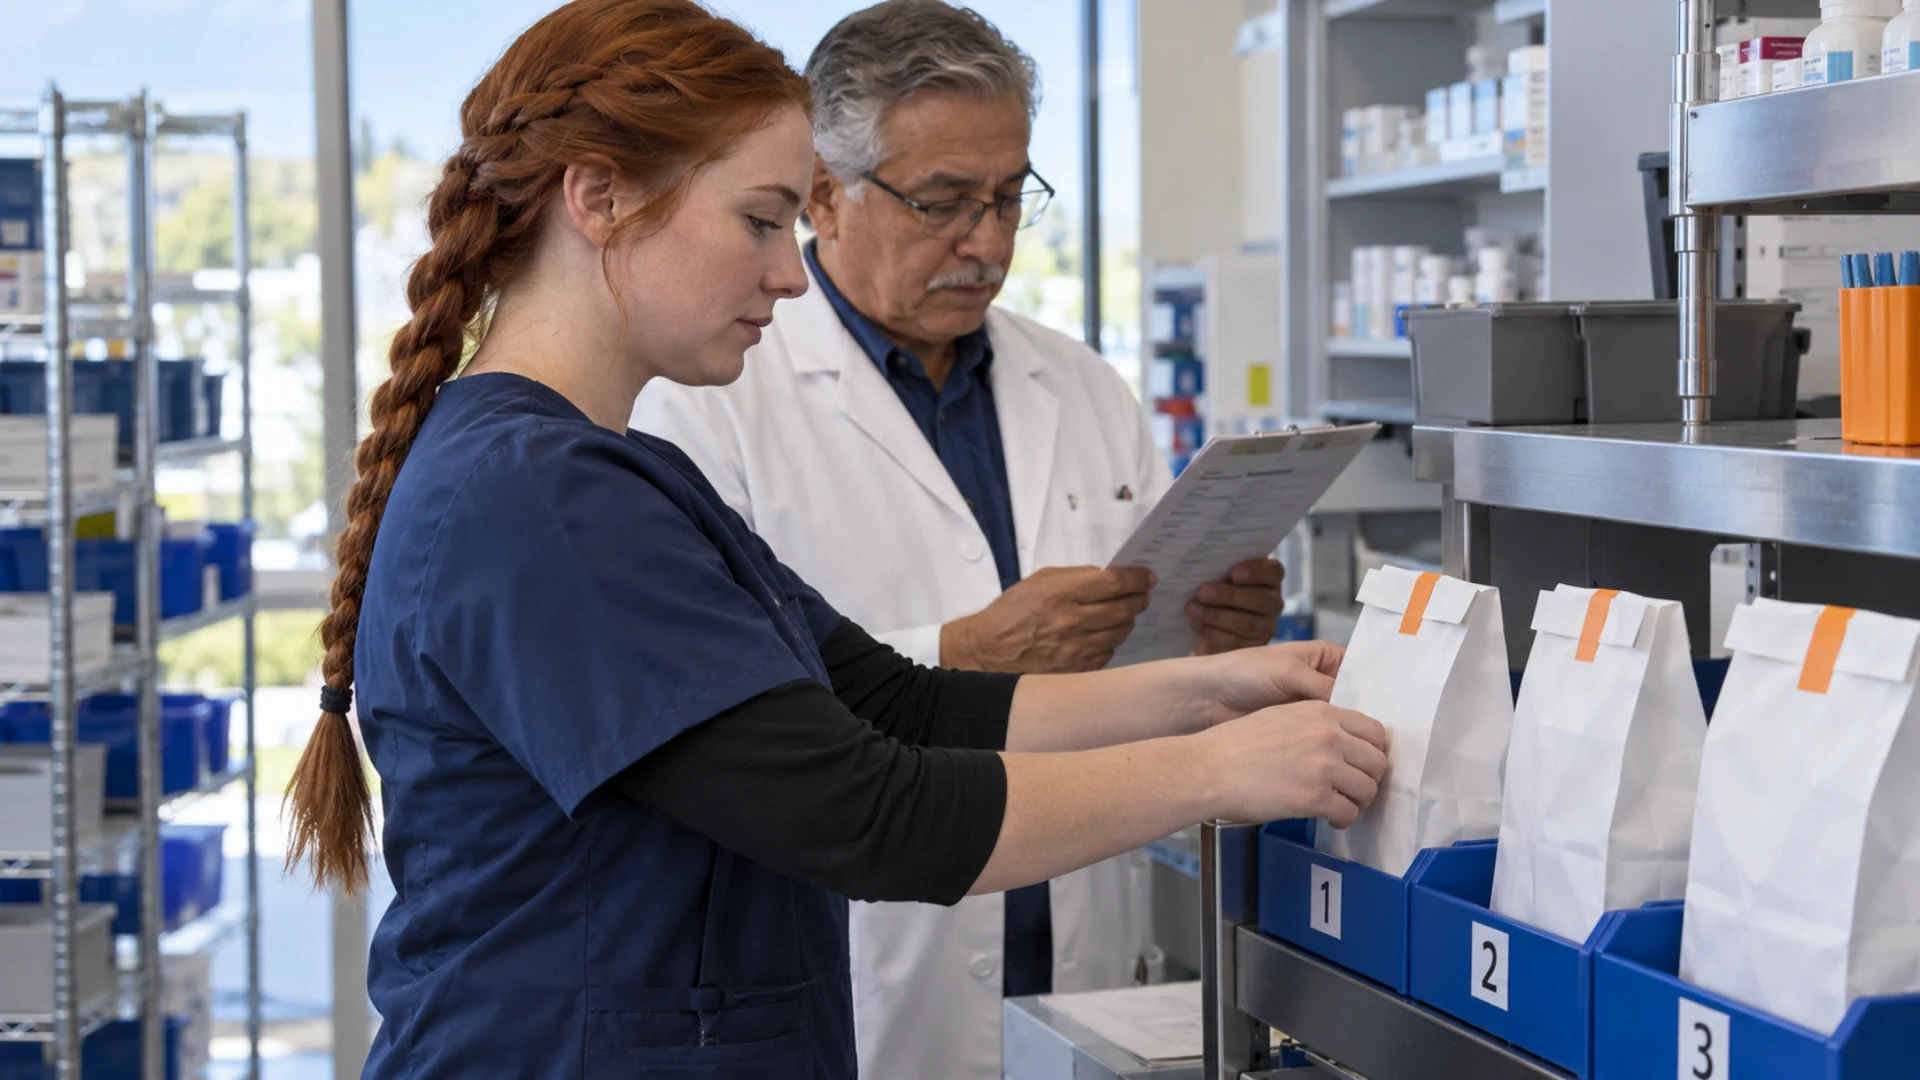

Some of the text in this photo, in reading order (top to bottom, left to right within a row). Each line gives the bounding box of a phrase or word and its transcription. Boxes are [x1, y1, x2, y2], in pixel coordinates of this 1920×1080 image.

[1320, 880, 1330, 924] 1
[1481, 940, 1498, 994] 2
[1692, 1022, 1713, 1080] 3
